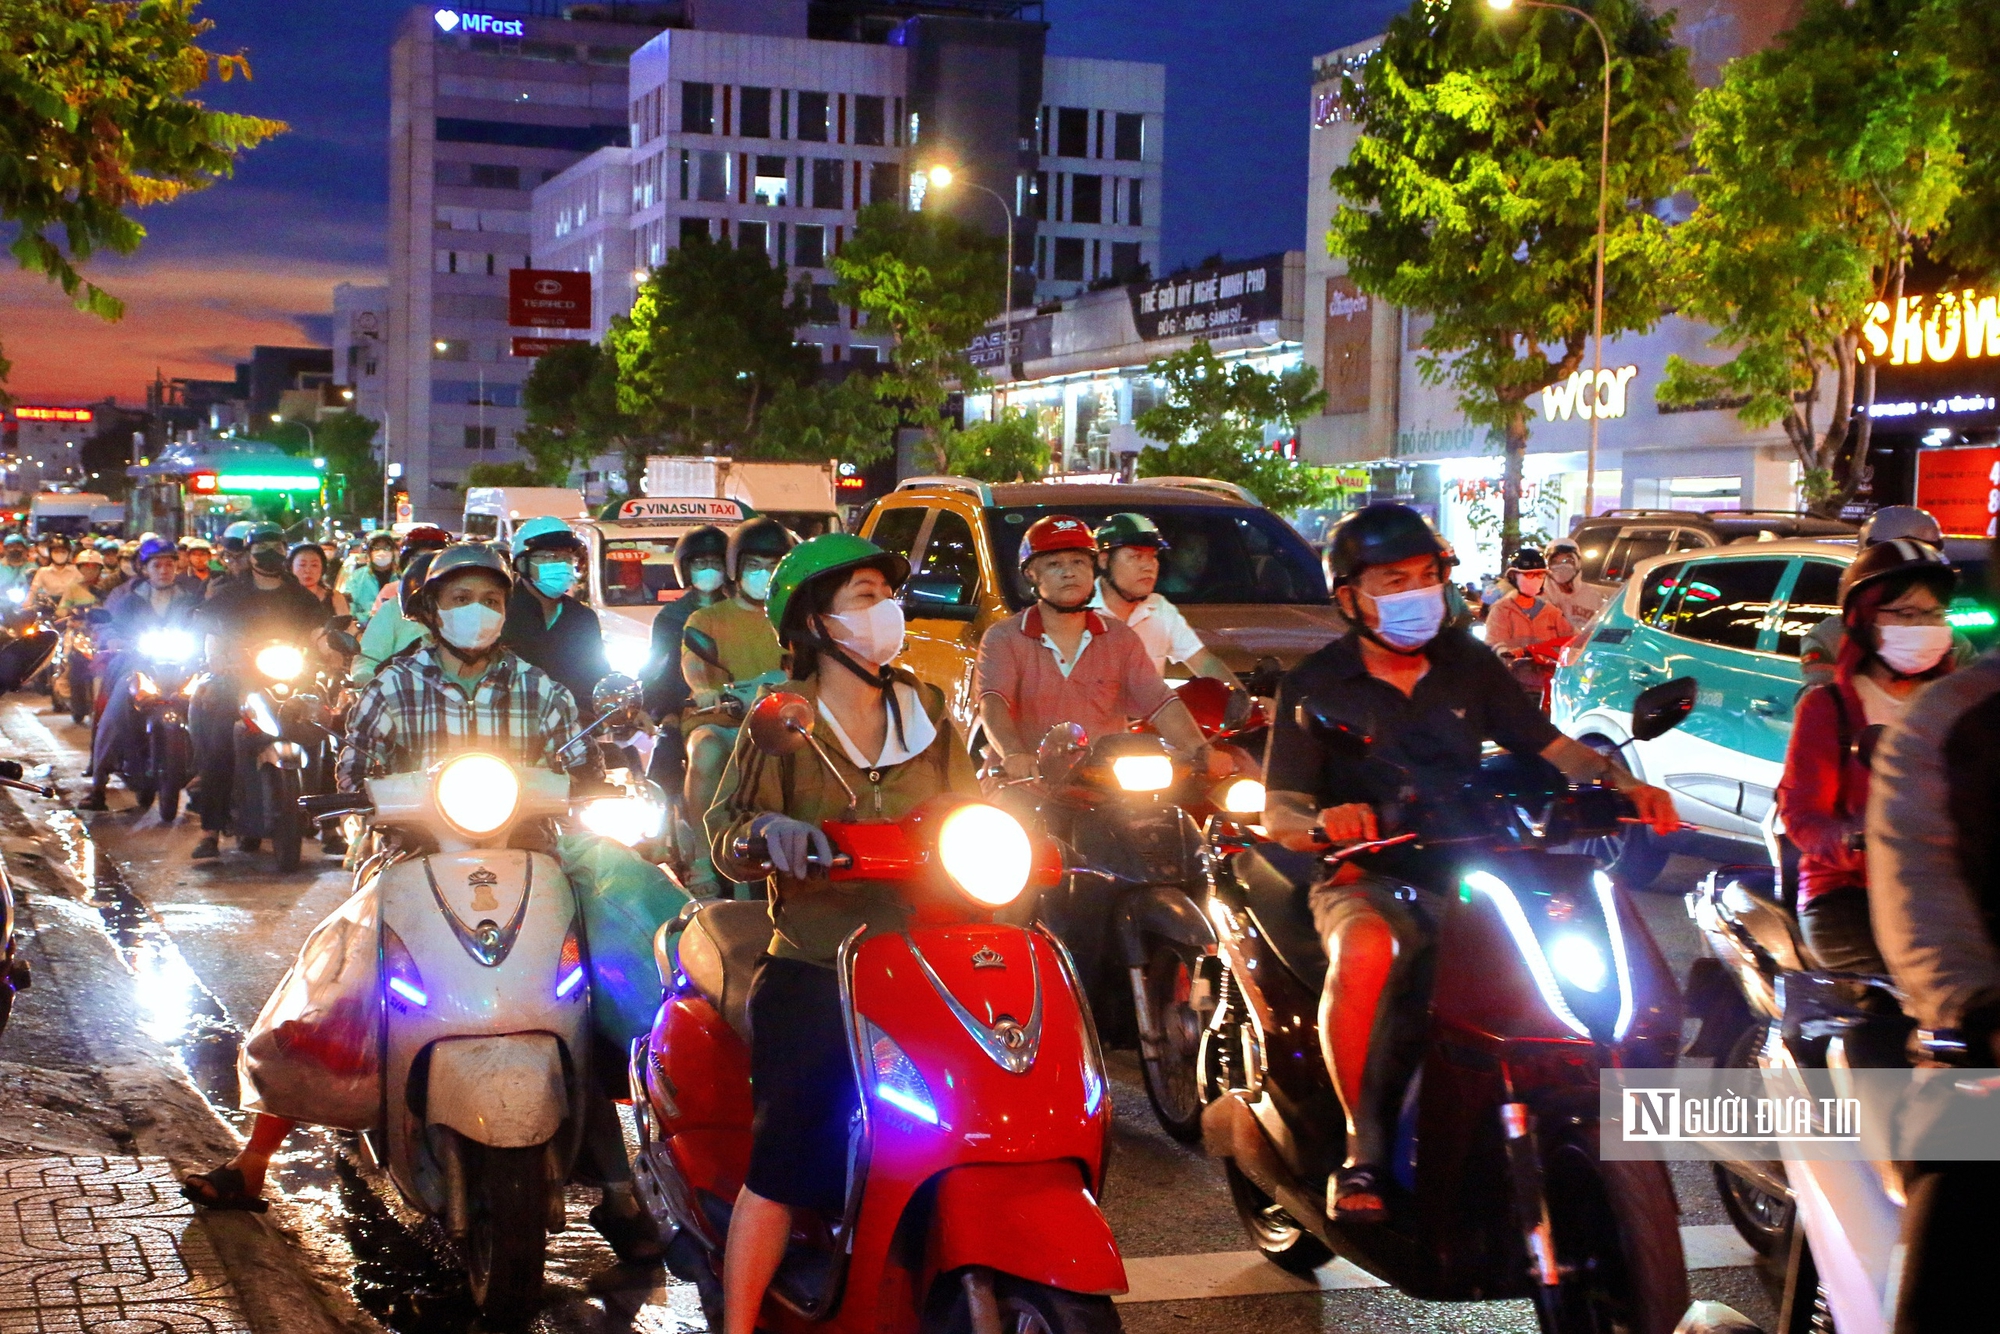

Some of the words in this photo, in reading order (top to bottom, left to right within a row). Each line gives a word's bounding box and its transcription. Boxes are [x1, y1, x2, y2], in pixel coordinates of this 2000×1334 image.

[462, 13, 524, 36] MFast
[1543, 365, 1637, 422] wcar
[647, 503, 706, 514] VINASUN
[710, 503, 735, 515] TAXI
